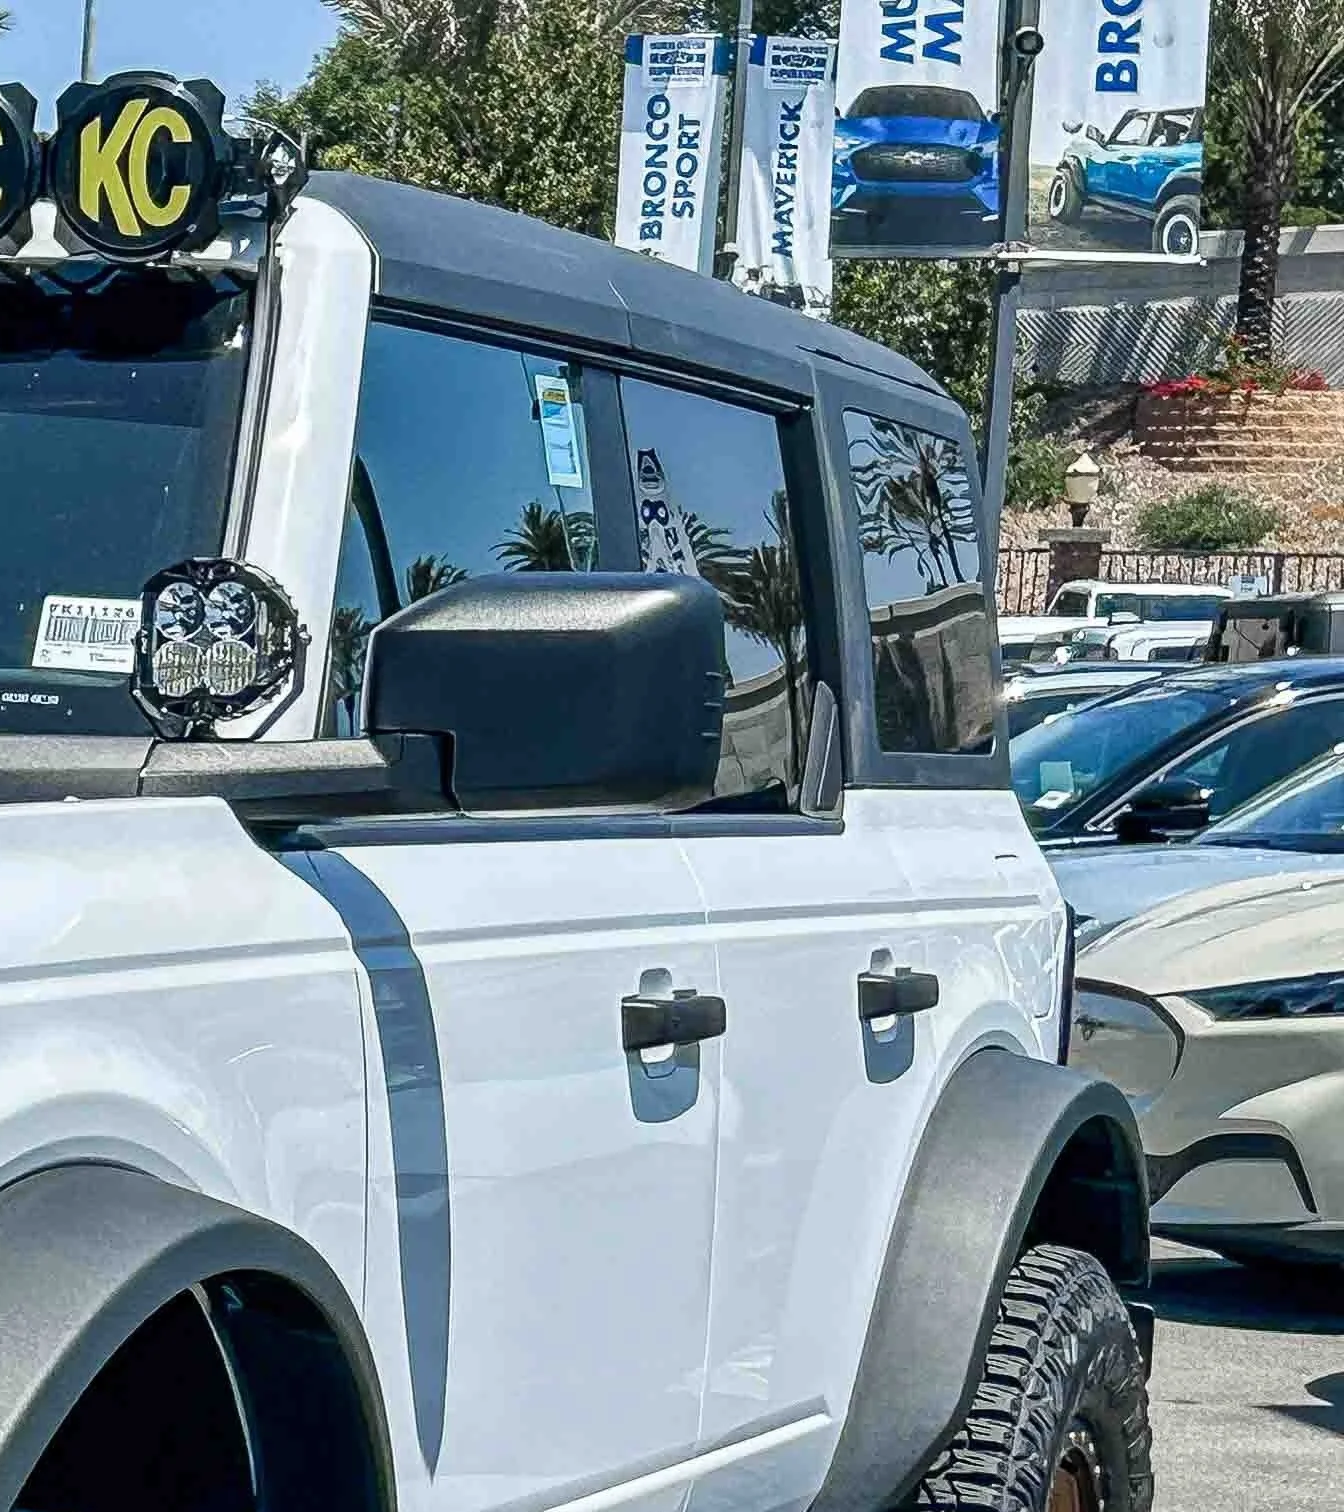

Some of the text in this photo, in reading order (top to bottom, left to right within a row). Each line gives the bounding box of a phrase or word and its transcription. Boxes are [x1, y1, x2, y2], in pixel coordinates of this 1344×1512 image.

[79, 98, 192, 237] KC
[639, 94, 671, 241] BRONCO
[671, 113, 701, 219] SPORT
[771, 100, 804, 258] MAVERICK
